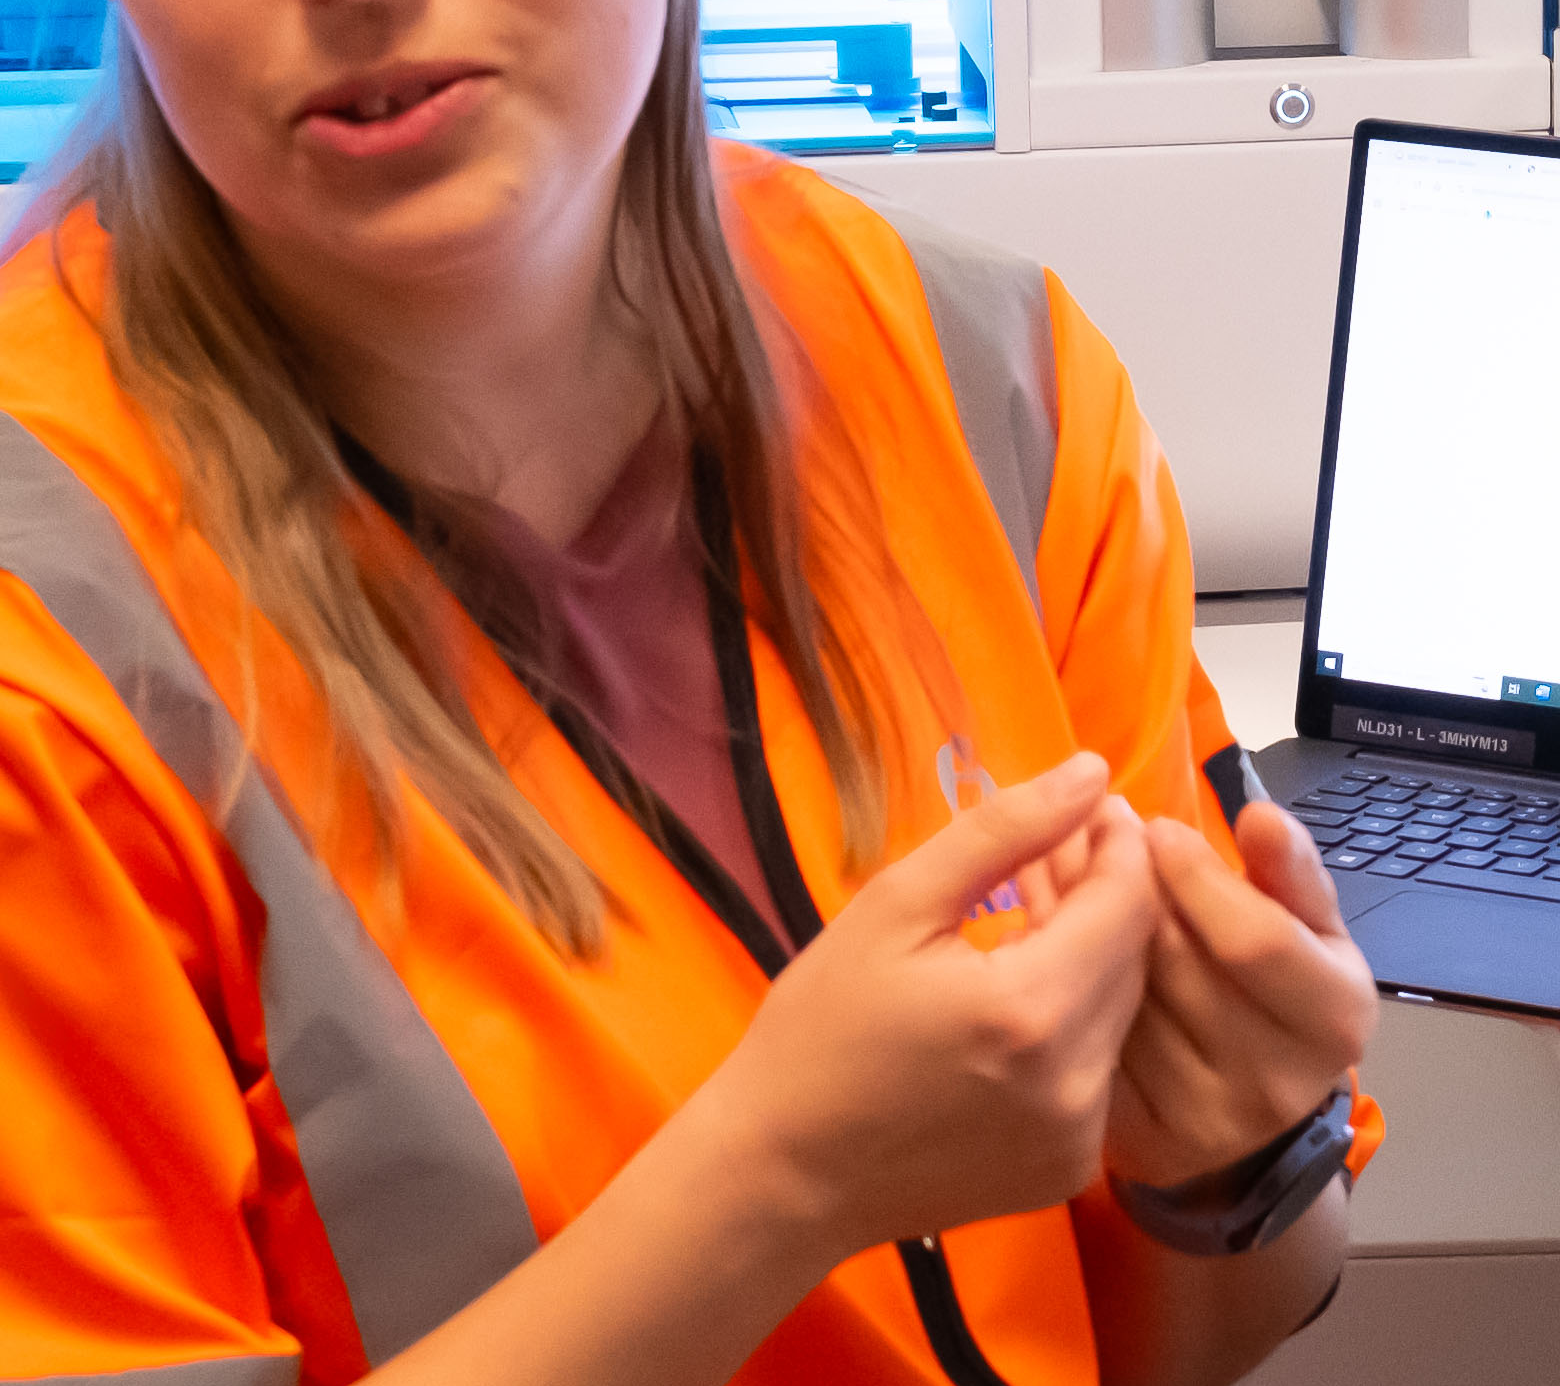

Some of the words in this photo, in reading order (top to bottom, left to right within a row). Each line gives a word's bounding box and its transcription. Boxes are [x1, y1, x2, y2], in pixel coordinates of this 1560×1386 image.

[1356, 718, 1403, 738] NLD31
[1416, 727, 1425, 741] L
[1438, 730, 1508, 753] 3MHYM13
